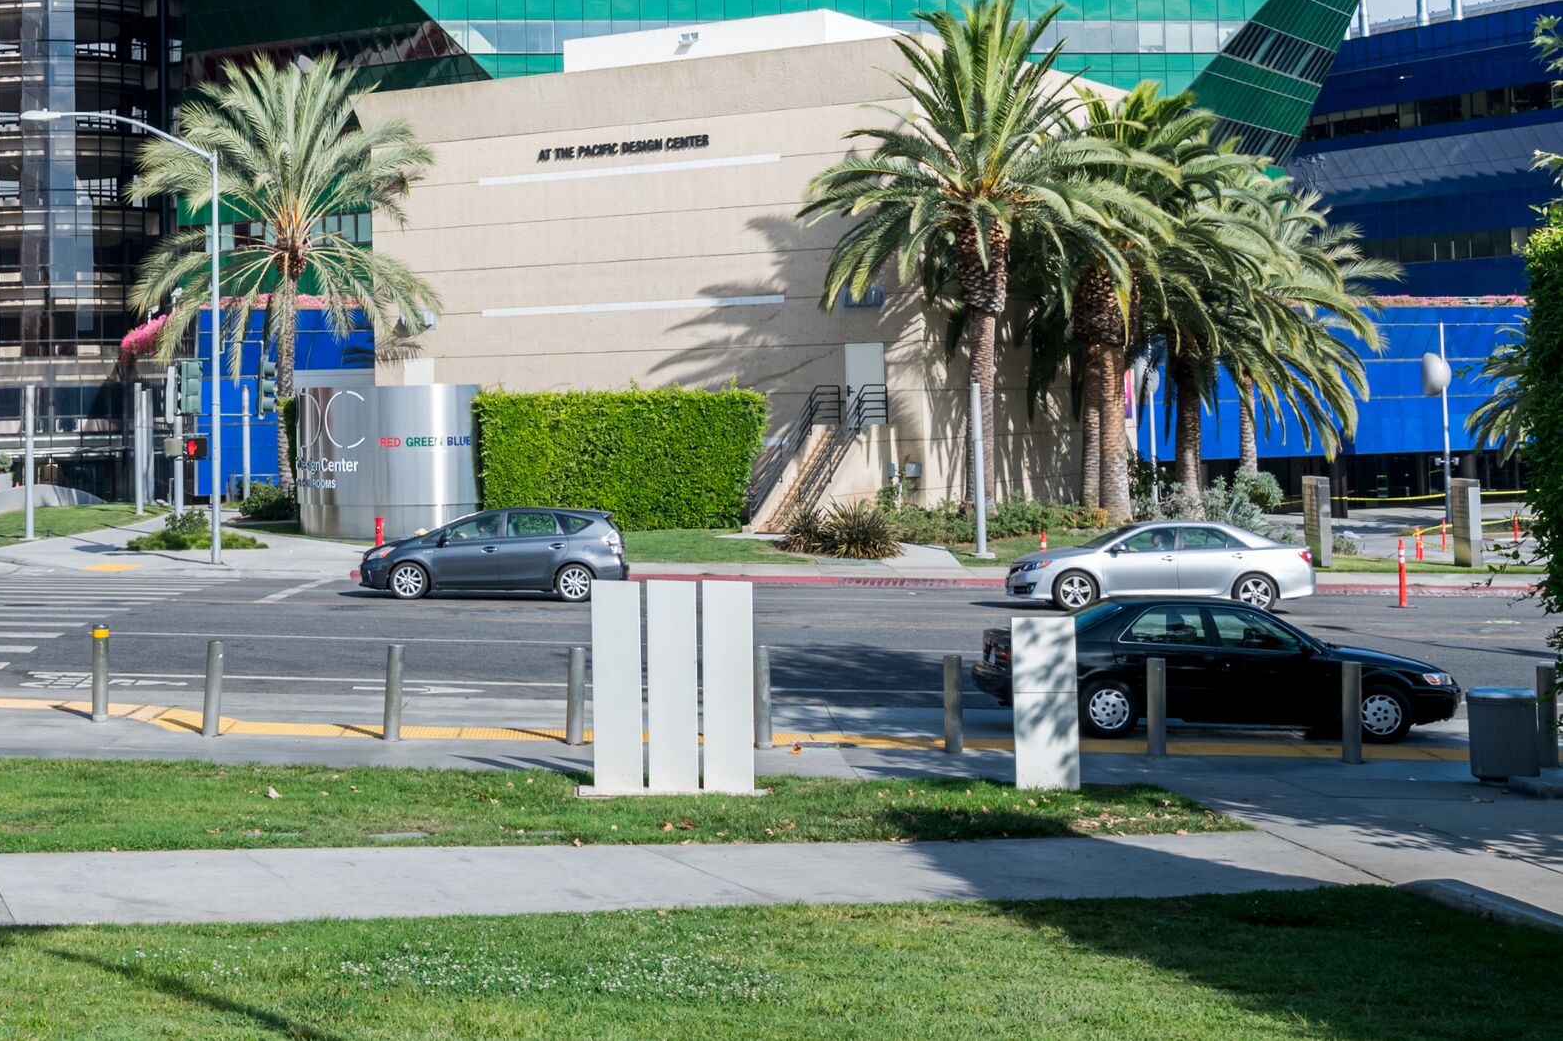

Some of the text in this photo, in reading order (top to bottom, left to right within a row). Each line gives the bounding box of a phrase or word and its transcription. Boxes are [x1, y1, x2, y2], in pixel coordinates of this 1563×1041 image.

[538, 134, 710, 161] AT THE PACIFIC DESIGN CENTER
[379, 435, 471, 447] RED GREEN BLUE
